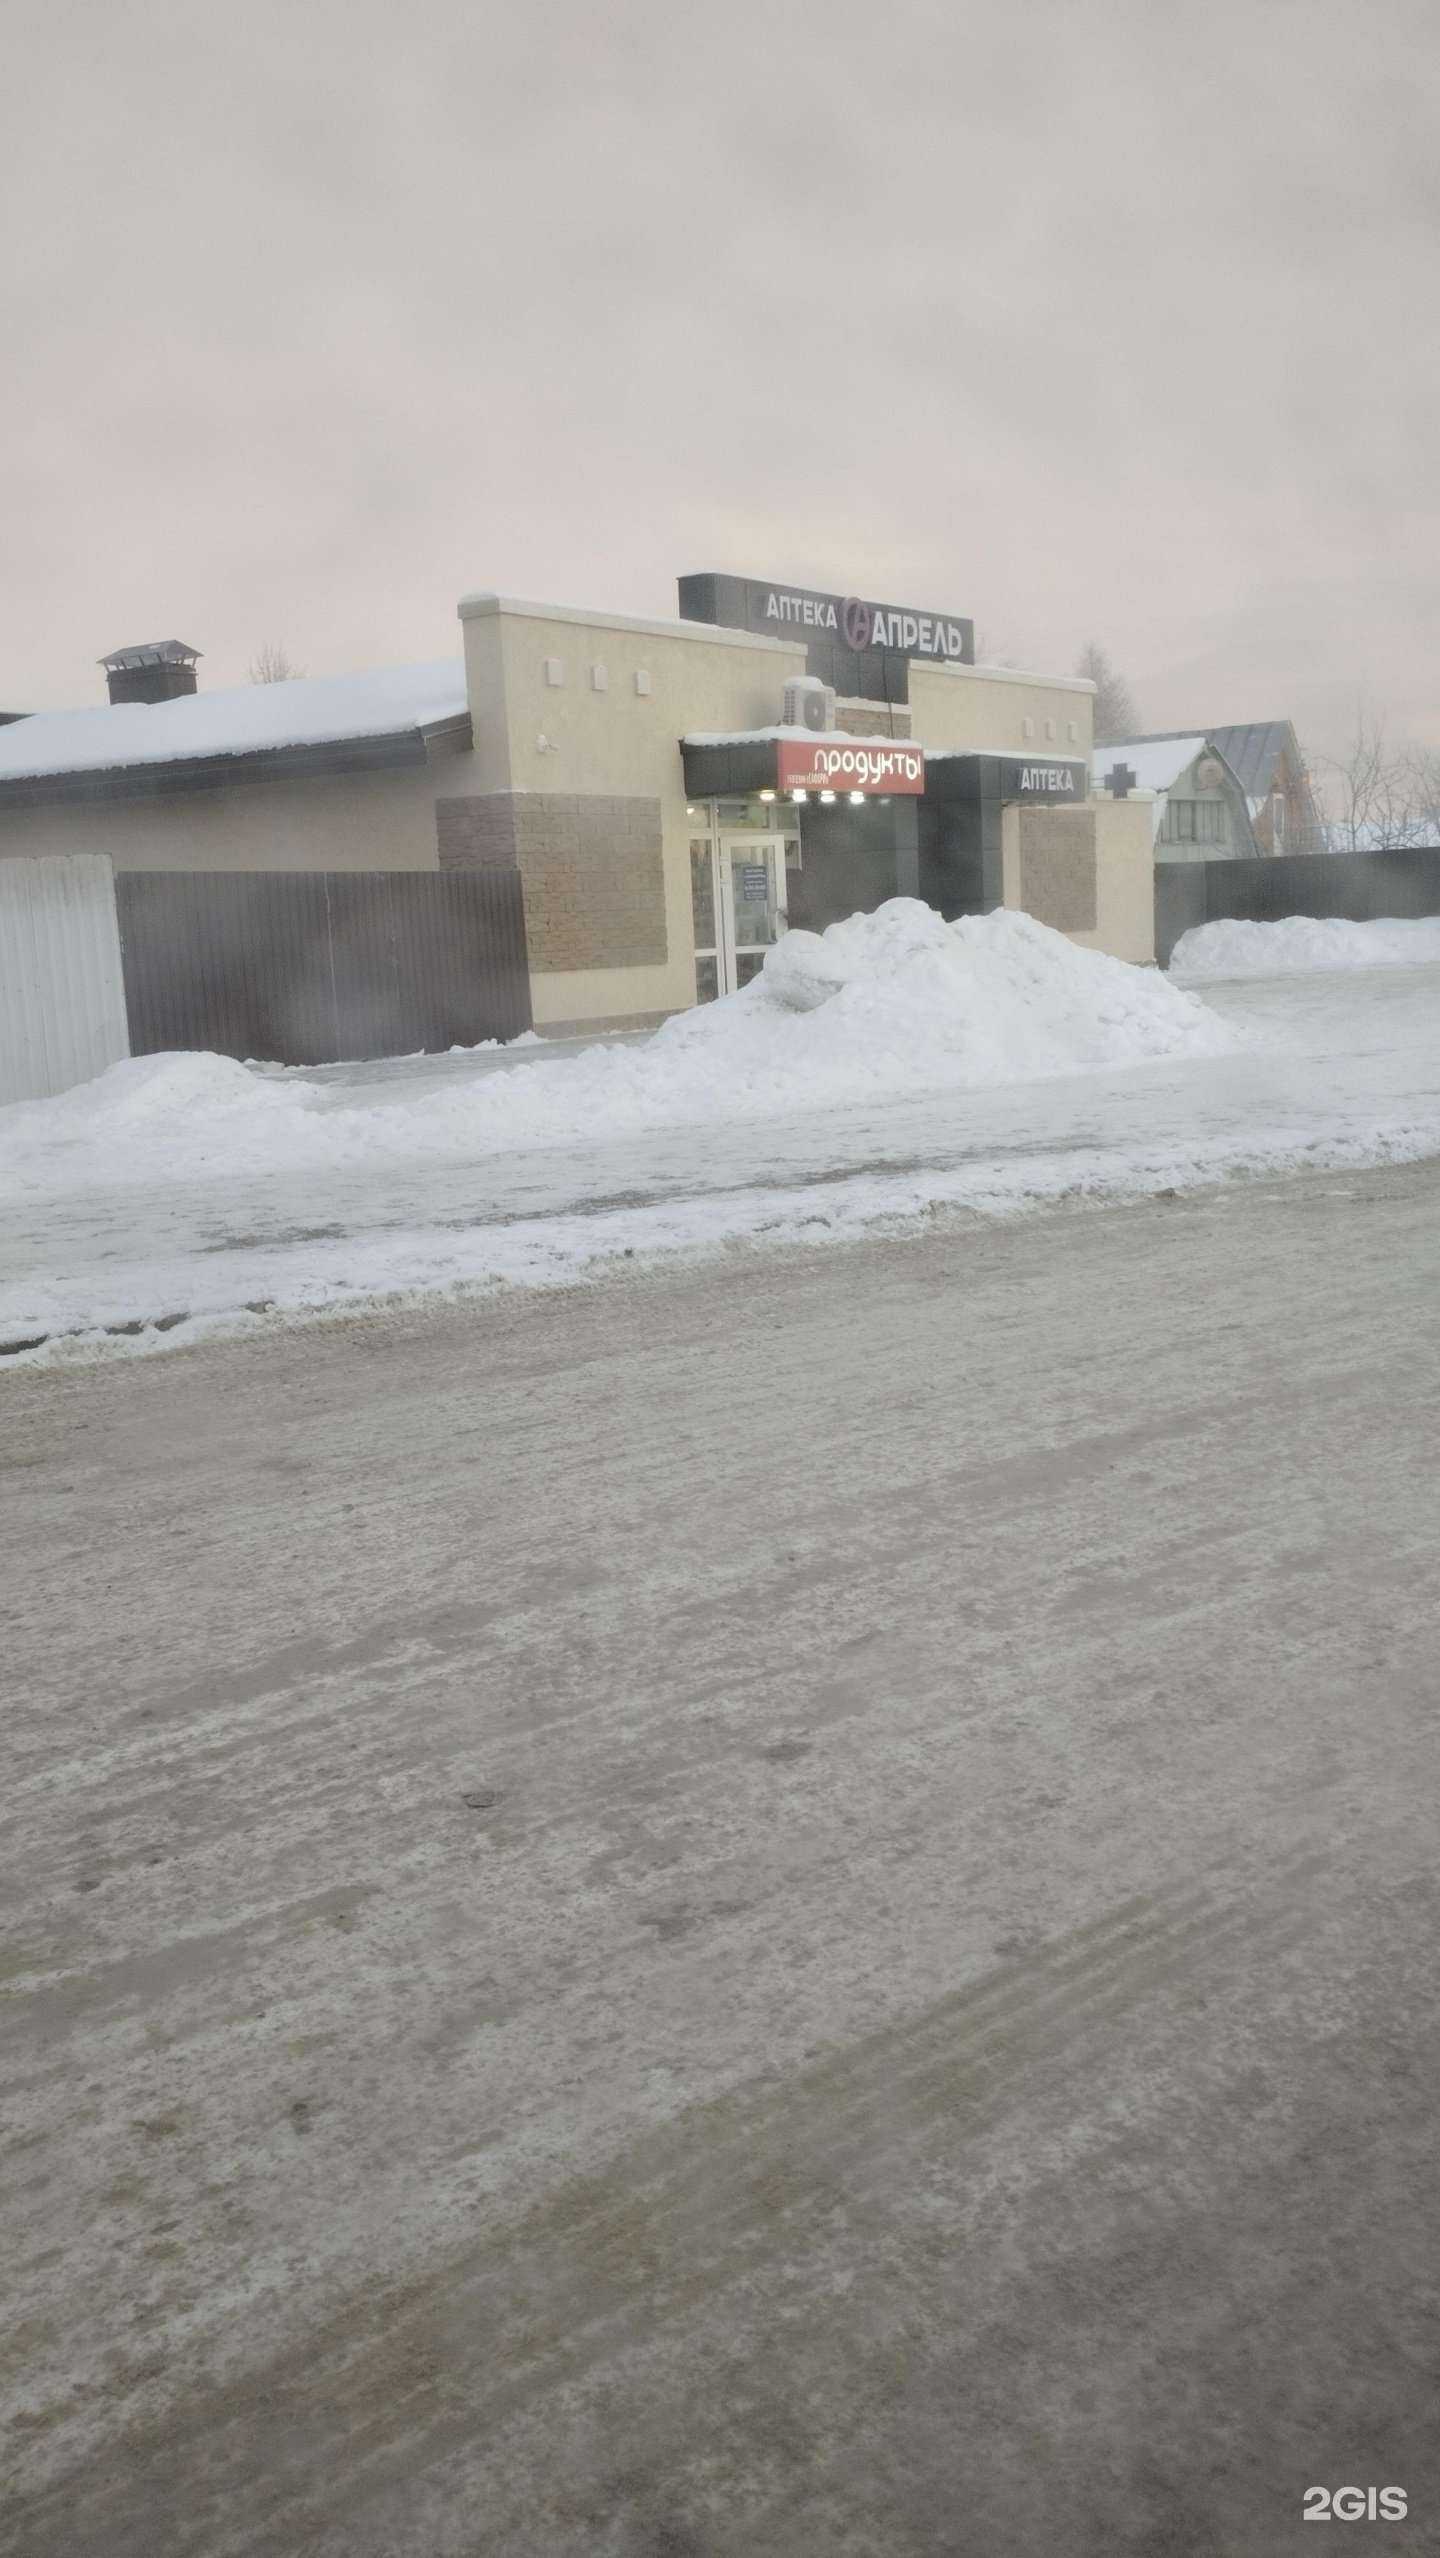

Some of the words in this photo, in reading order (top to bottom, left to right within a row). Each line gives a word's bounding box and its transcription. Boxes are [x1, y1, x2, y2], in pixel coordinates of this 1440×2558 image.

[766, 593, 838, 629] АПТЕКА
[871, 611, 962, 656] АПРЕЛЬ
[1020, 767, 1074, 792] АПТЕКА
